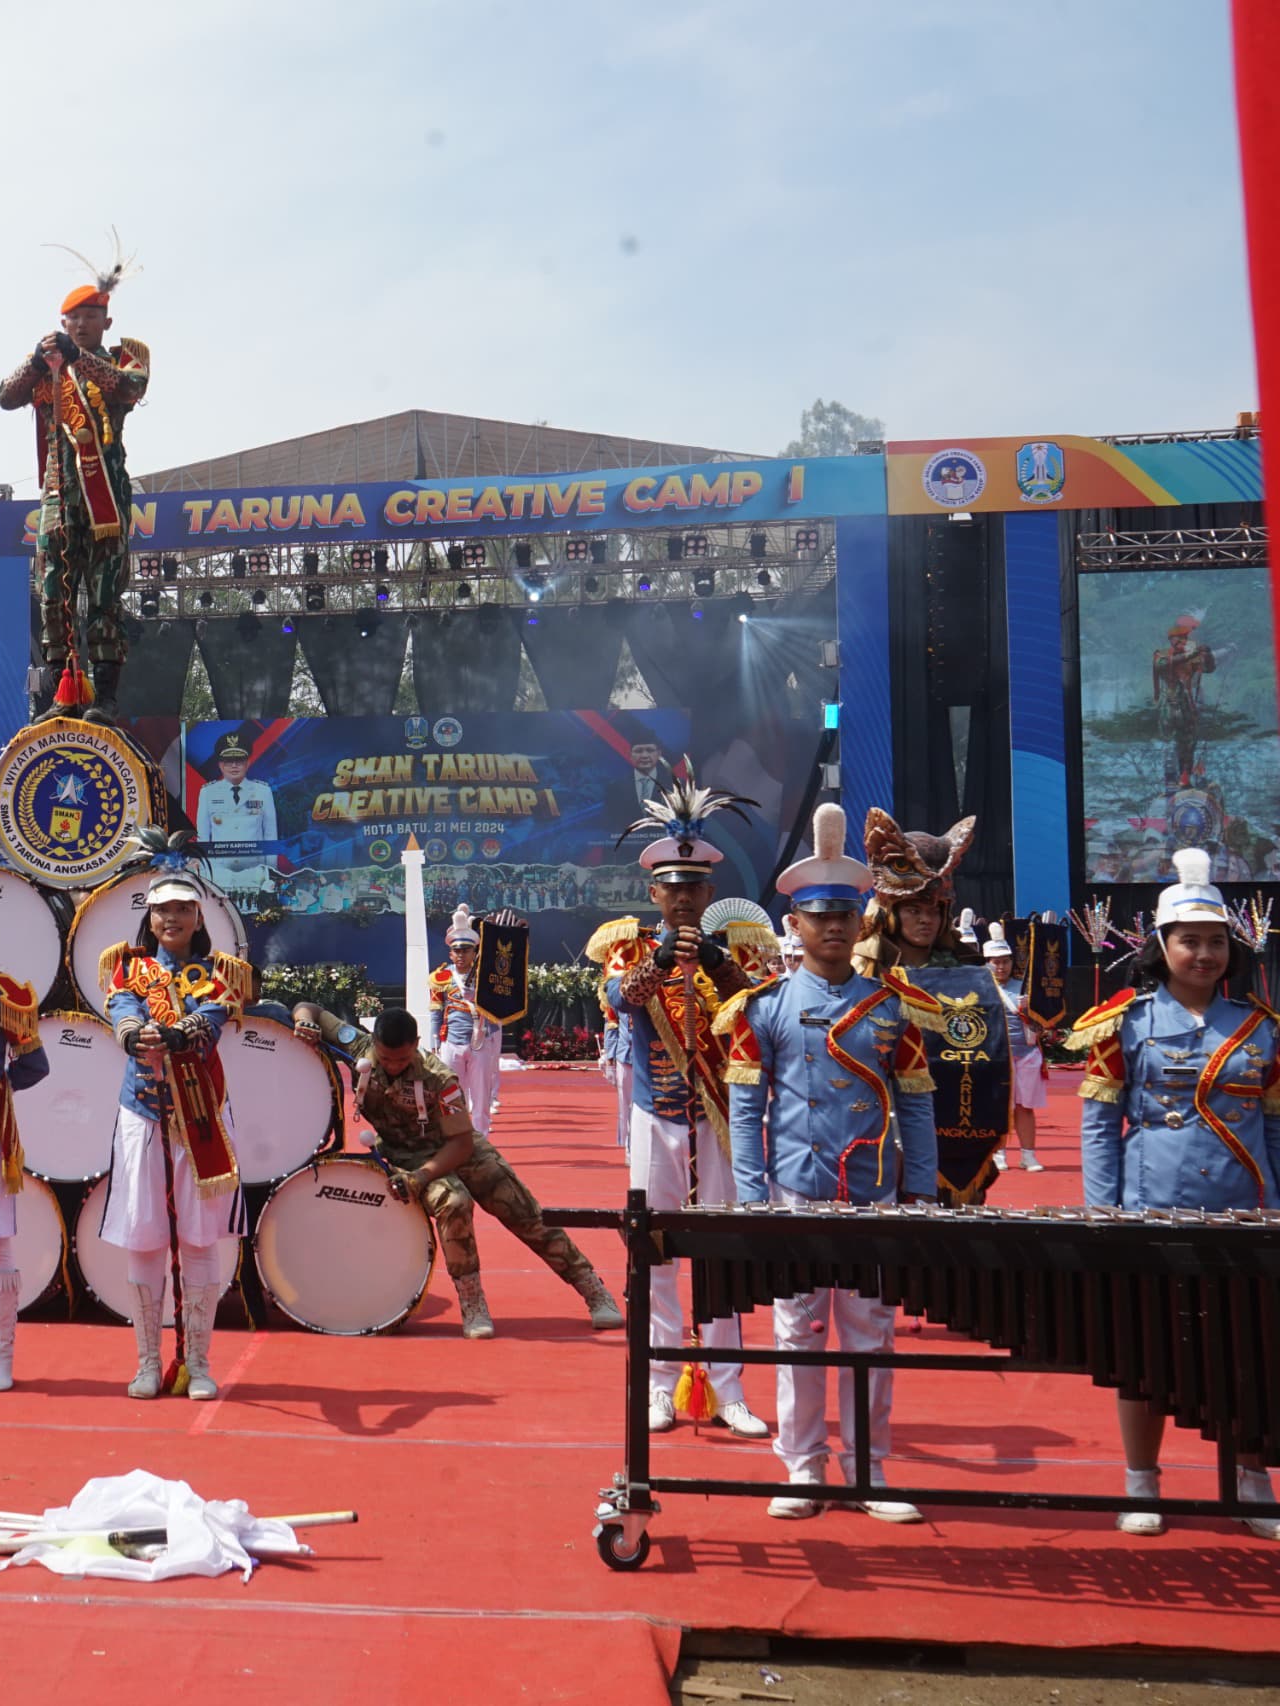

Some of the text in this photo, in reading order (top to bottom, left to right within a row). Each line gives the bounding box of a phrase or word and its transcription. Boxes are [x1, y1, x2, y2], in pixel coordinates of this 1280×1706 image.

[21, 465, 806, 545] SN TARUNA CREATIVE CAMP I
[4, 731, 138, 805] WIYATA MANGGALA NAGARA
[333, 753, 539, 787] SMAN TARUNA
[311, 786, 452, 821] CREATIVE
[458, 786, 539, 816] CAMP
[0, 804, 133, 875] SMAN 3 TARUNA ANGKASA MADUN
[363, 823, 393, 836] KOTA
[434, 822, 446, 833] 21
[450, 821, 470, 833] MEI
[474, 821, 505, 834] 2024
[939, 1049, 991, 1062] GITA
[315, 1185, 386, 1207] ROLLING
